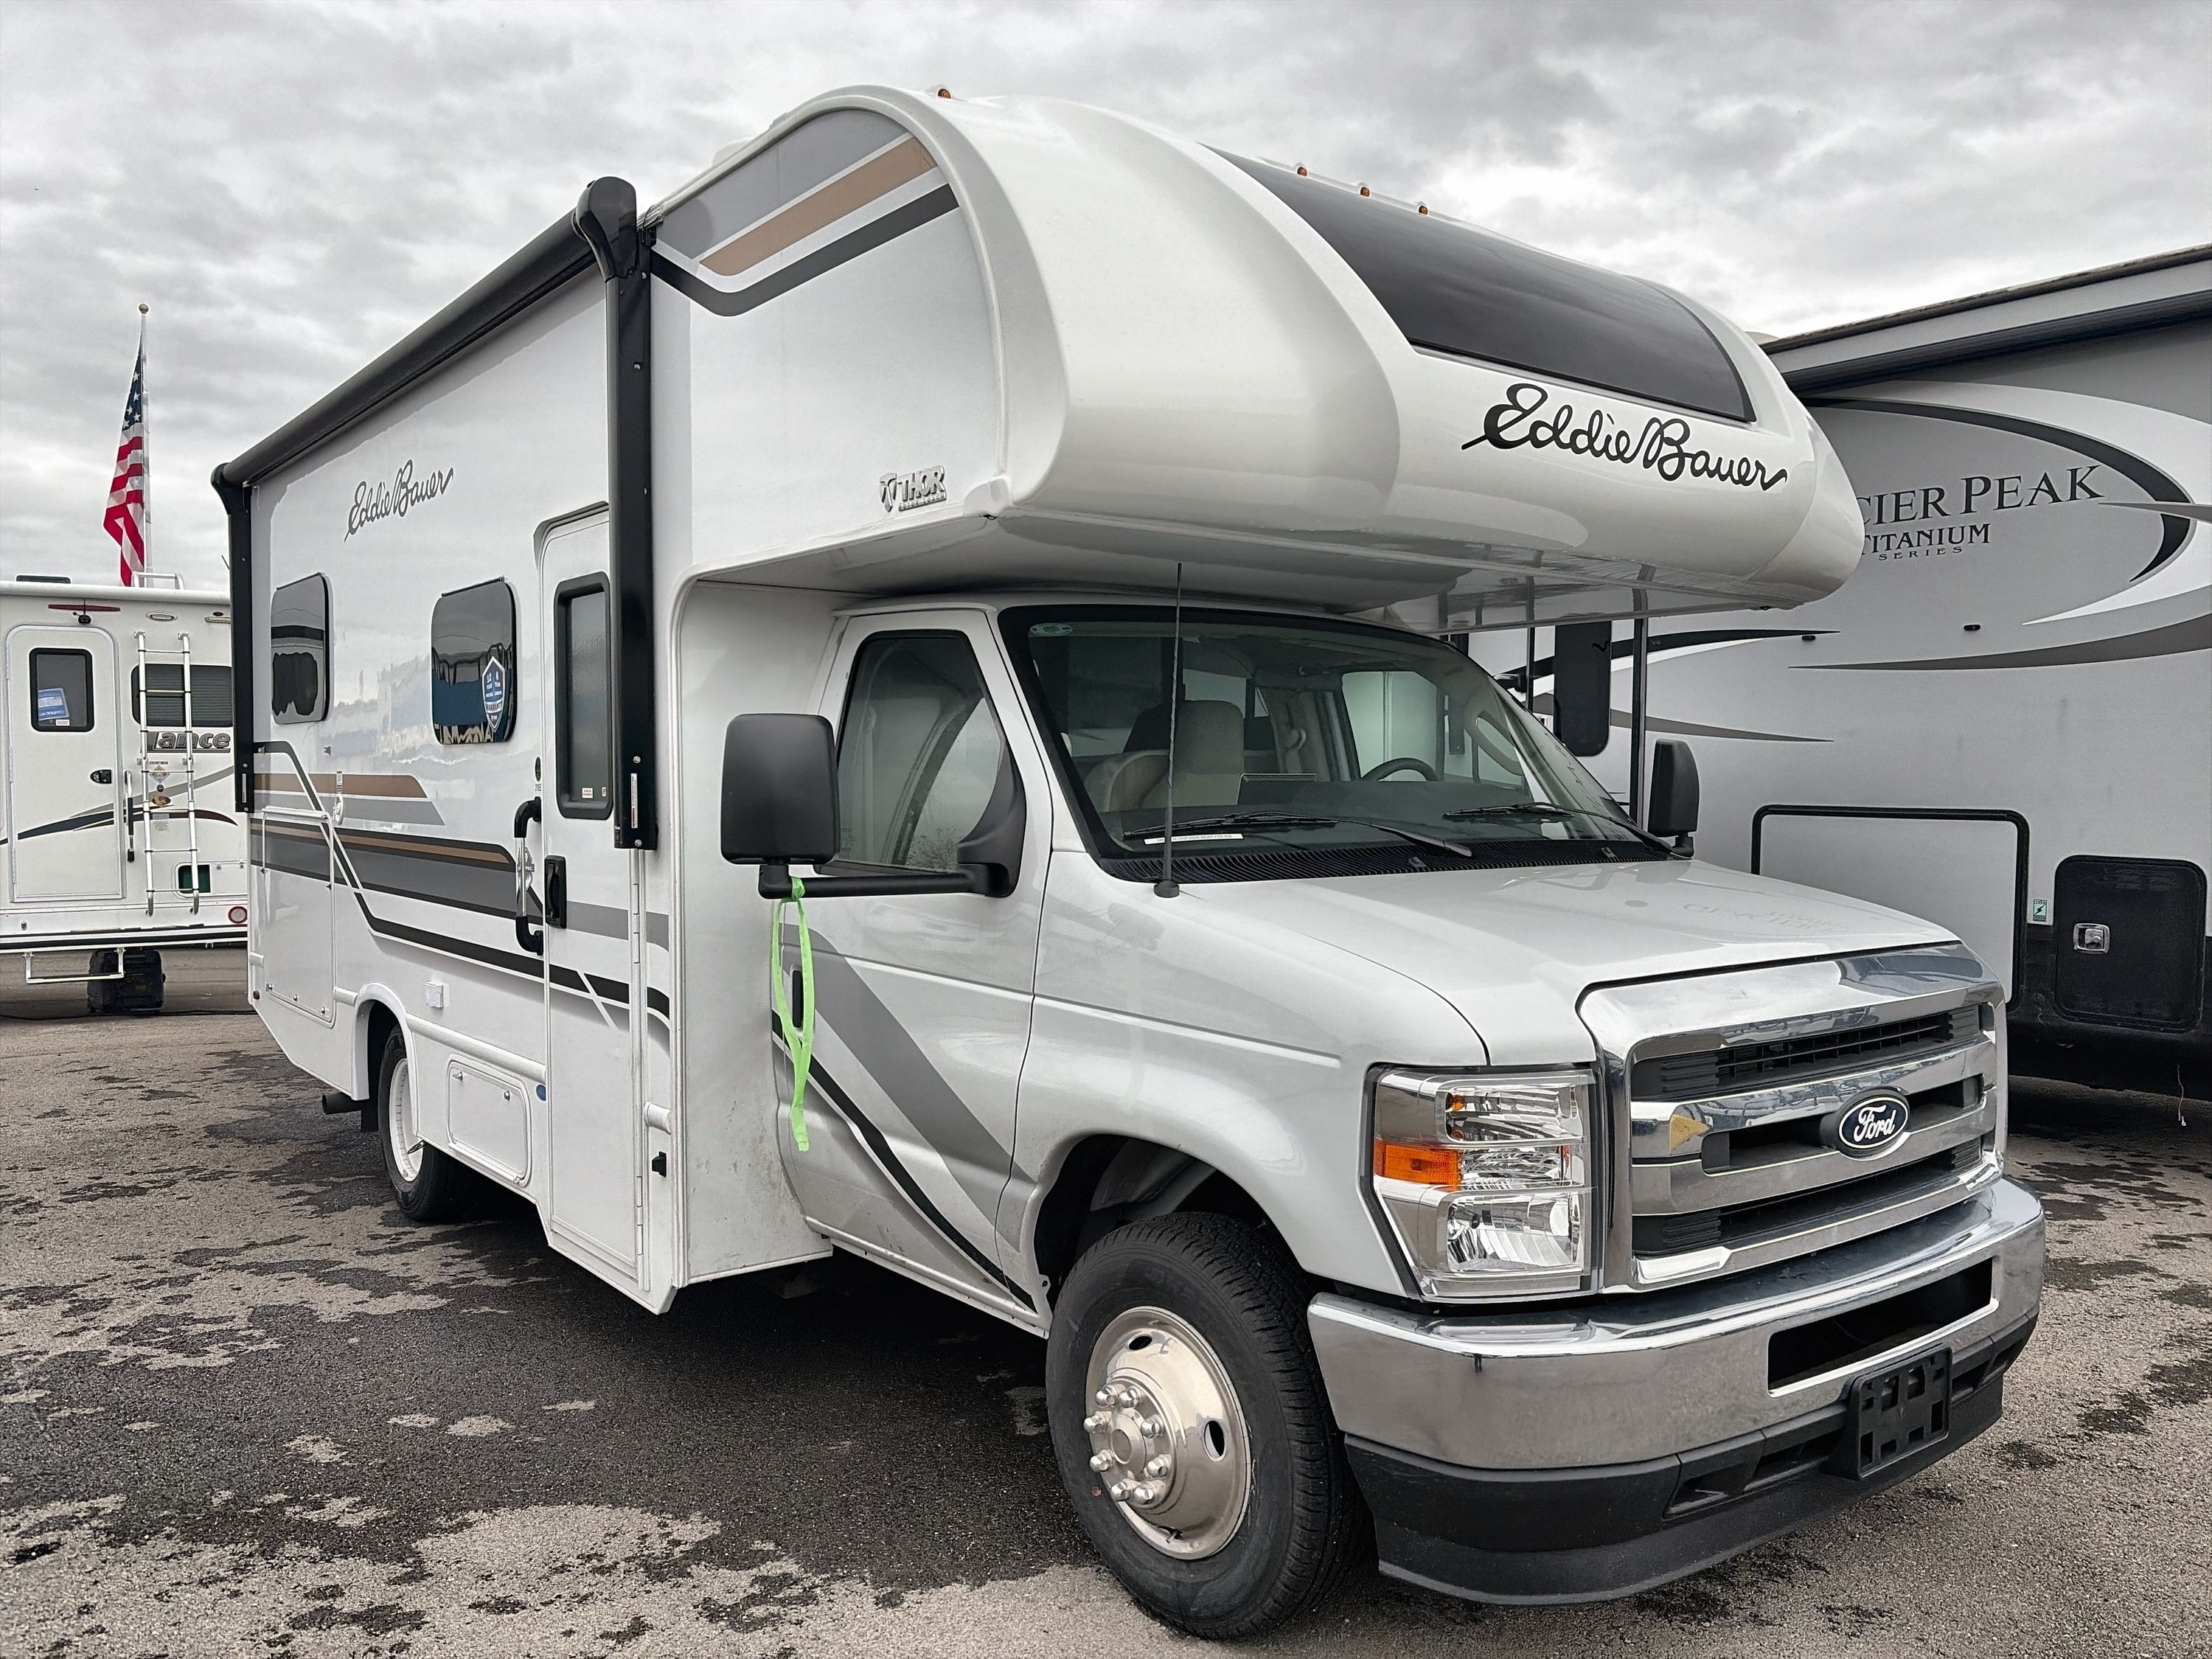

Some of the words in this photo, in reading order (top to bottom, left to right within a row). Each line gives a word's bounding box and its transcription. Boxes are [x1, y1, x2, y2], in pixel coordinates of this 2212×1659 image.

[1461, 383, 1632, 464] Eddie
[1641, 417, 1788, 491] Bauer
[344, 481, 391, 542] Eddie
[392, 459, 454, 518] Bauer
[897, 465, 946, 502] THOR
[1959, 465, 2107, 515] PEAK
[1878, 546, 1963, 561] SERIES
[1853, 1105, 1897, 1143] Ford
